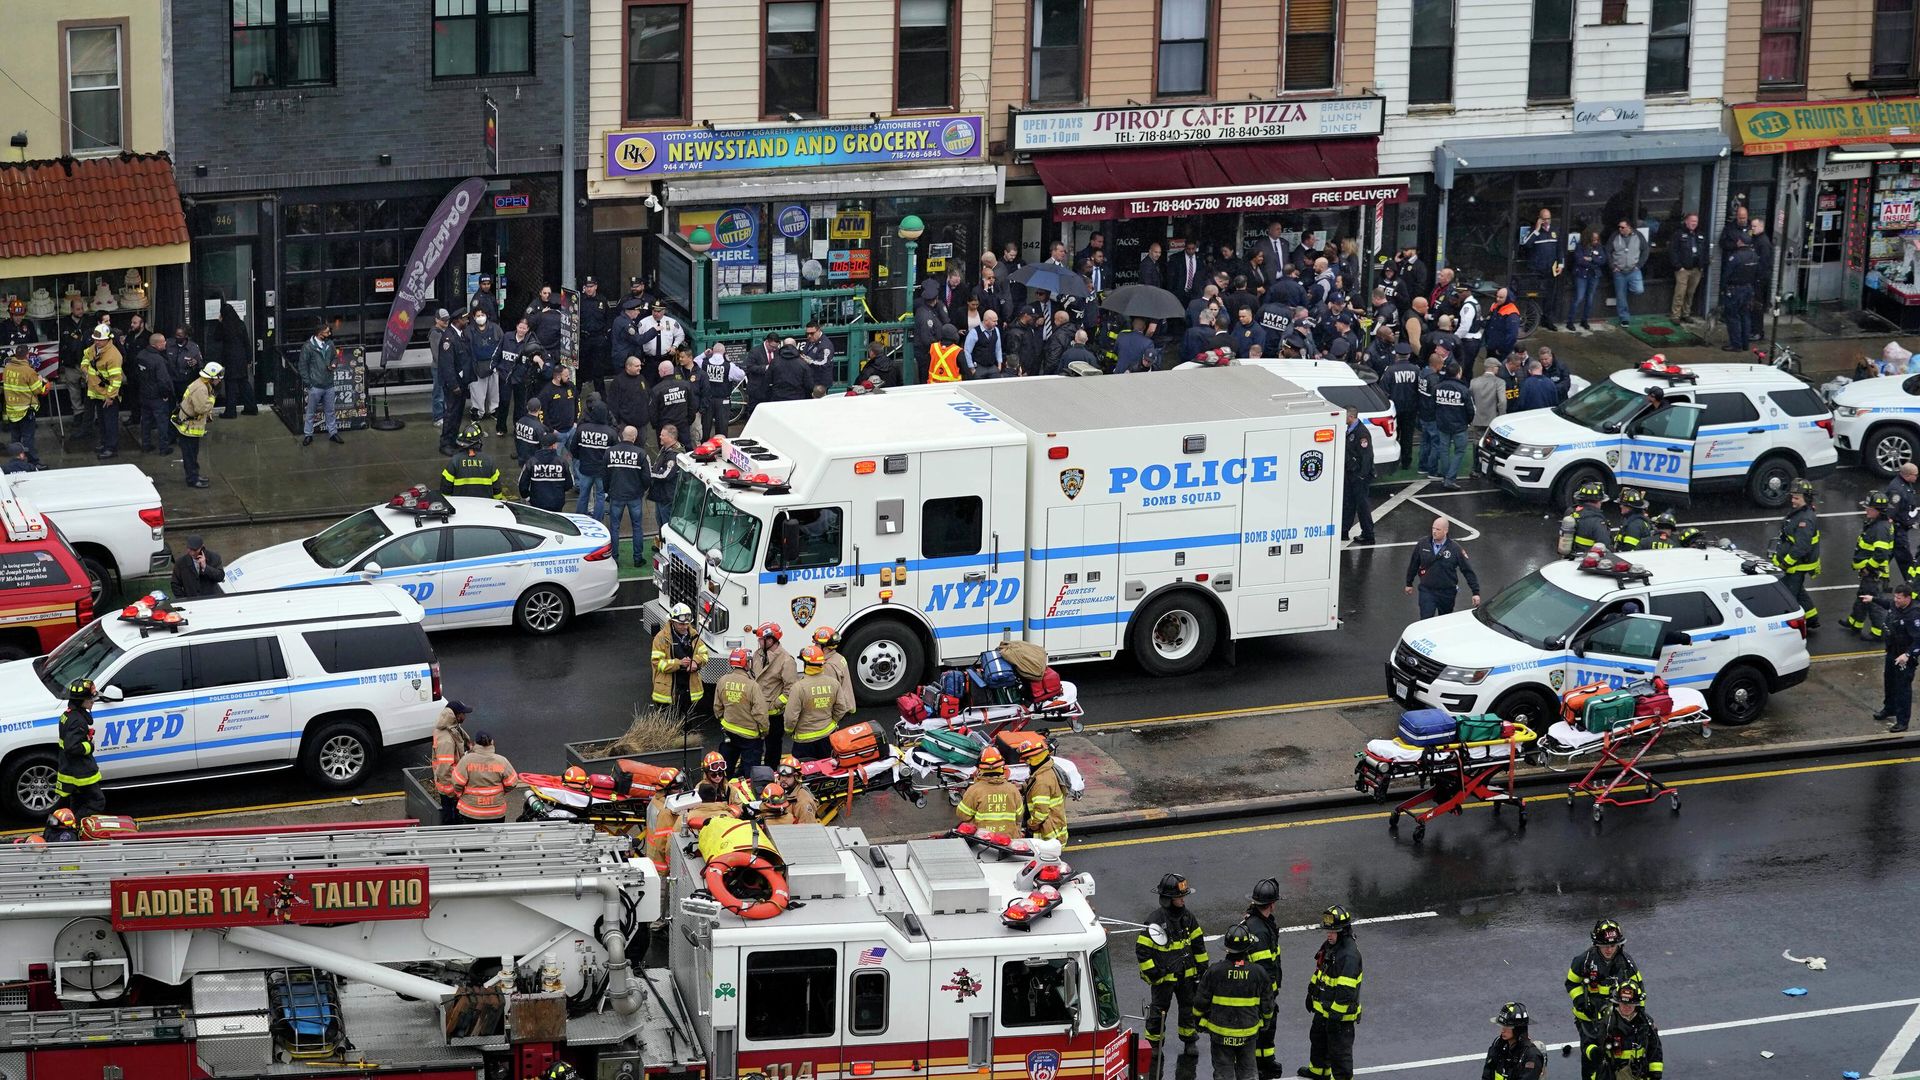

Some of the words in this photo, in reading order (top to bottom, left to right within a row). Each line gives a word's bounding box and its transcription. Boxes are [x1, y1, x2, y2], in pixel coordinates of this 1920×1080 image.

[1321, 102, 1374, 112] BREAKFAST
[1023, 118, 1048, 130] OPEN
[1050, 118, 1056, 130] 7
[1059, 117, 1083, 130] DAYS
[1093, 110, 1175, 132] SPIRO'S
[1182, 106, 1235, 127] CAFE
[1245, 104, 1307, 124] PIZZA
[1321, 114, 1362, 122] LUNCH
[1794, 108, 1848, 130] FRUITS
[1852, 106, 1863, 128] &
[663, 133, 686, 141] LOTTO
[753, 128, 794, 136] CIGARETTES
[874, 122, 921, 130] STATIONERIES
[1115, 132, 1134, 142] TEL:
[1139, 129, 1210, 142] 718-840-5780
[1218, 125, 1285, 138] 718-840-5831
[1320, 124, 1357, 134] DINER
[1026, 132, 1080, 144] 5am-10pm
[669, 138, 789, 162] NEWSSTAND
[795, 136, 837, 156] AND
[843, 130, 929, 154] GROCERY
[623, 144, 648, 164] RK
[892, 150, 942, 159] 718-768-6845
[496, 196, 528, 206] OPEN
[1312, 192, 1341, 202] FREE
[1344, 189, 1399, 201] DELIVERY
[1130, 202, 1150, 214] TEL:
[1152, 197, 1219, 212] 718-840-5780
[1226, 194, 1289, 208] 718-840-5831
[1885, 204, 1912, 214] ATM
[1063, 207, 1076, 216] 942
[1078, 206, 1090, 214] 4th
[1092, 206, 1106, 214] Ave
[216, 216, 232, 226] 946
[735, 220, 750, 230] YORK
[837, 218, 865, 232] ATM
[783, 222, 806, 233] LOTTERY
[719, 227, 752, 244] LOTTERY
[1023, 241, 1040, 250] 942
[1116, 238, 1140, 246] TACOS
[717, 250, 754, 260] HERE.
[850, 261, 870, 272] 302
[1263, 312, 1289, 325] NYPD
[1262, 319, 1288, 330] POLICE
[707, 365, 724, 374] NYPD
[1394, 371, 1416, 384] NYPD
[664, 391, 686, 402] FDNY
[1436, 390, 1462, 399] NYPD
[516, 422, 534, 434] NYPD
[581, 431, 608, 442] NYPD
[582, 438, 608, 446] POLICE
[1573, 441, 1596, 450] POLICE
[610, 450, 638, 460] NYPD
[1628, 451, 1681, 474] NYPD
[534, 464, 562, 474] NYPD
[1108, 456, 1278, 494] POLICE
[1143, 496, 1176, 506] BOMB
[1182, 492, 1221, 505] SQUAD
[1244, 530, 1268, 543] BOMB
[1270, 528, 1298, 542] SQUAD
[1304, 526, 1322, 538] 7091
[558, 558, 580, 566] SAFETY
[792, 566, 844, 582] POLICE
[924, 576, 1020, 612] NYPD
[1060, 585, 1096, 596] COURTESY
[1053, 595, 1116, 606] PROFESSIONALISM
[1047, 607, 1080, 618] RESPECT
[1410, 640, 1432, 656] POLICE
[1512, 660, 1538, 672] POLICE
[360, 676, 377, 685] BOMB
[379, 672, 398, 683] SQUAD
[404, 671, 418, 680] 5674
[226, 708, 254, 717] COURTESY
[222, 714, 270, 724] PROFESSIONALISM
[3, 721, 32, 732] POLICE
[100, 713, 184, 747] NYPD
[218, 724, 243, 732] RESPECT
[478, 797, 494, 806] EMT
[988, 794, 1008, 804] FDNY
[988, 804, 1007, 812] EMS
[121, 886, 214, 918] LADDER
[220, 886, 260, 914] 114
[312, 881, 383, 909] TALLY
[390, 878, 422, 906] HO
[1228, 970, 1250, 980] FDNY
[1111, 1036, 1128, 1052] STOPPING
